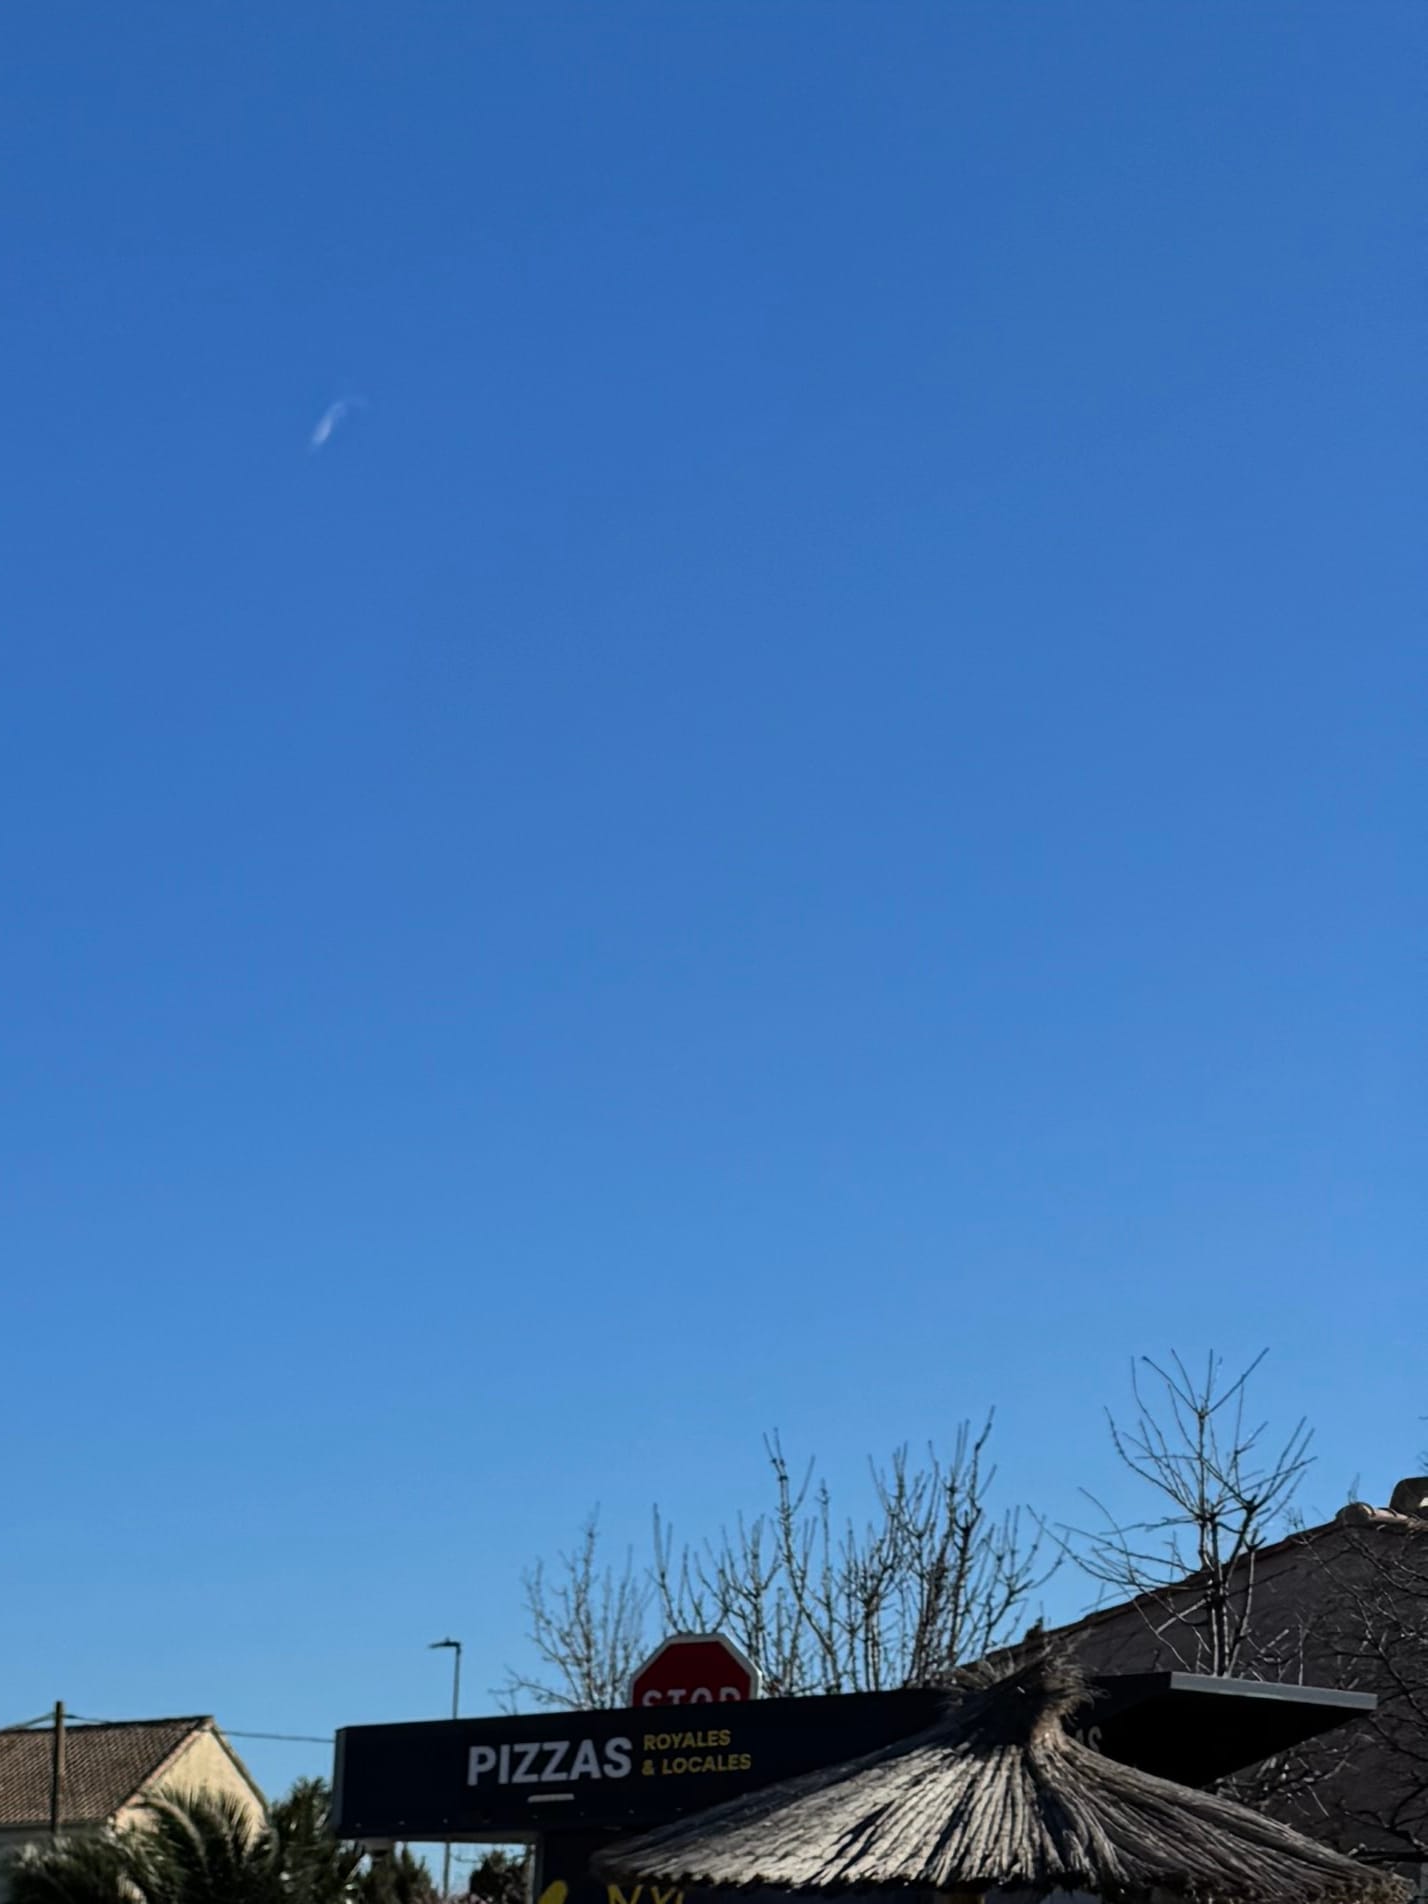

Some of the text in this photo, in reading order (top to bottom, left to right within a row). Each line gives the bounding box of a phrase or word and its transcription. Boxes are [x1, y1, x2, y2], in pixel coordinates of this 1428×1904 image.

[643, 1729, 732, 1751] ROYALES
[466, 1736, 633, 1787] PIZZAS
[641, 1753, 752, 1777] & LOCALES
